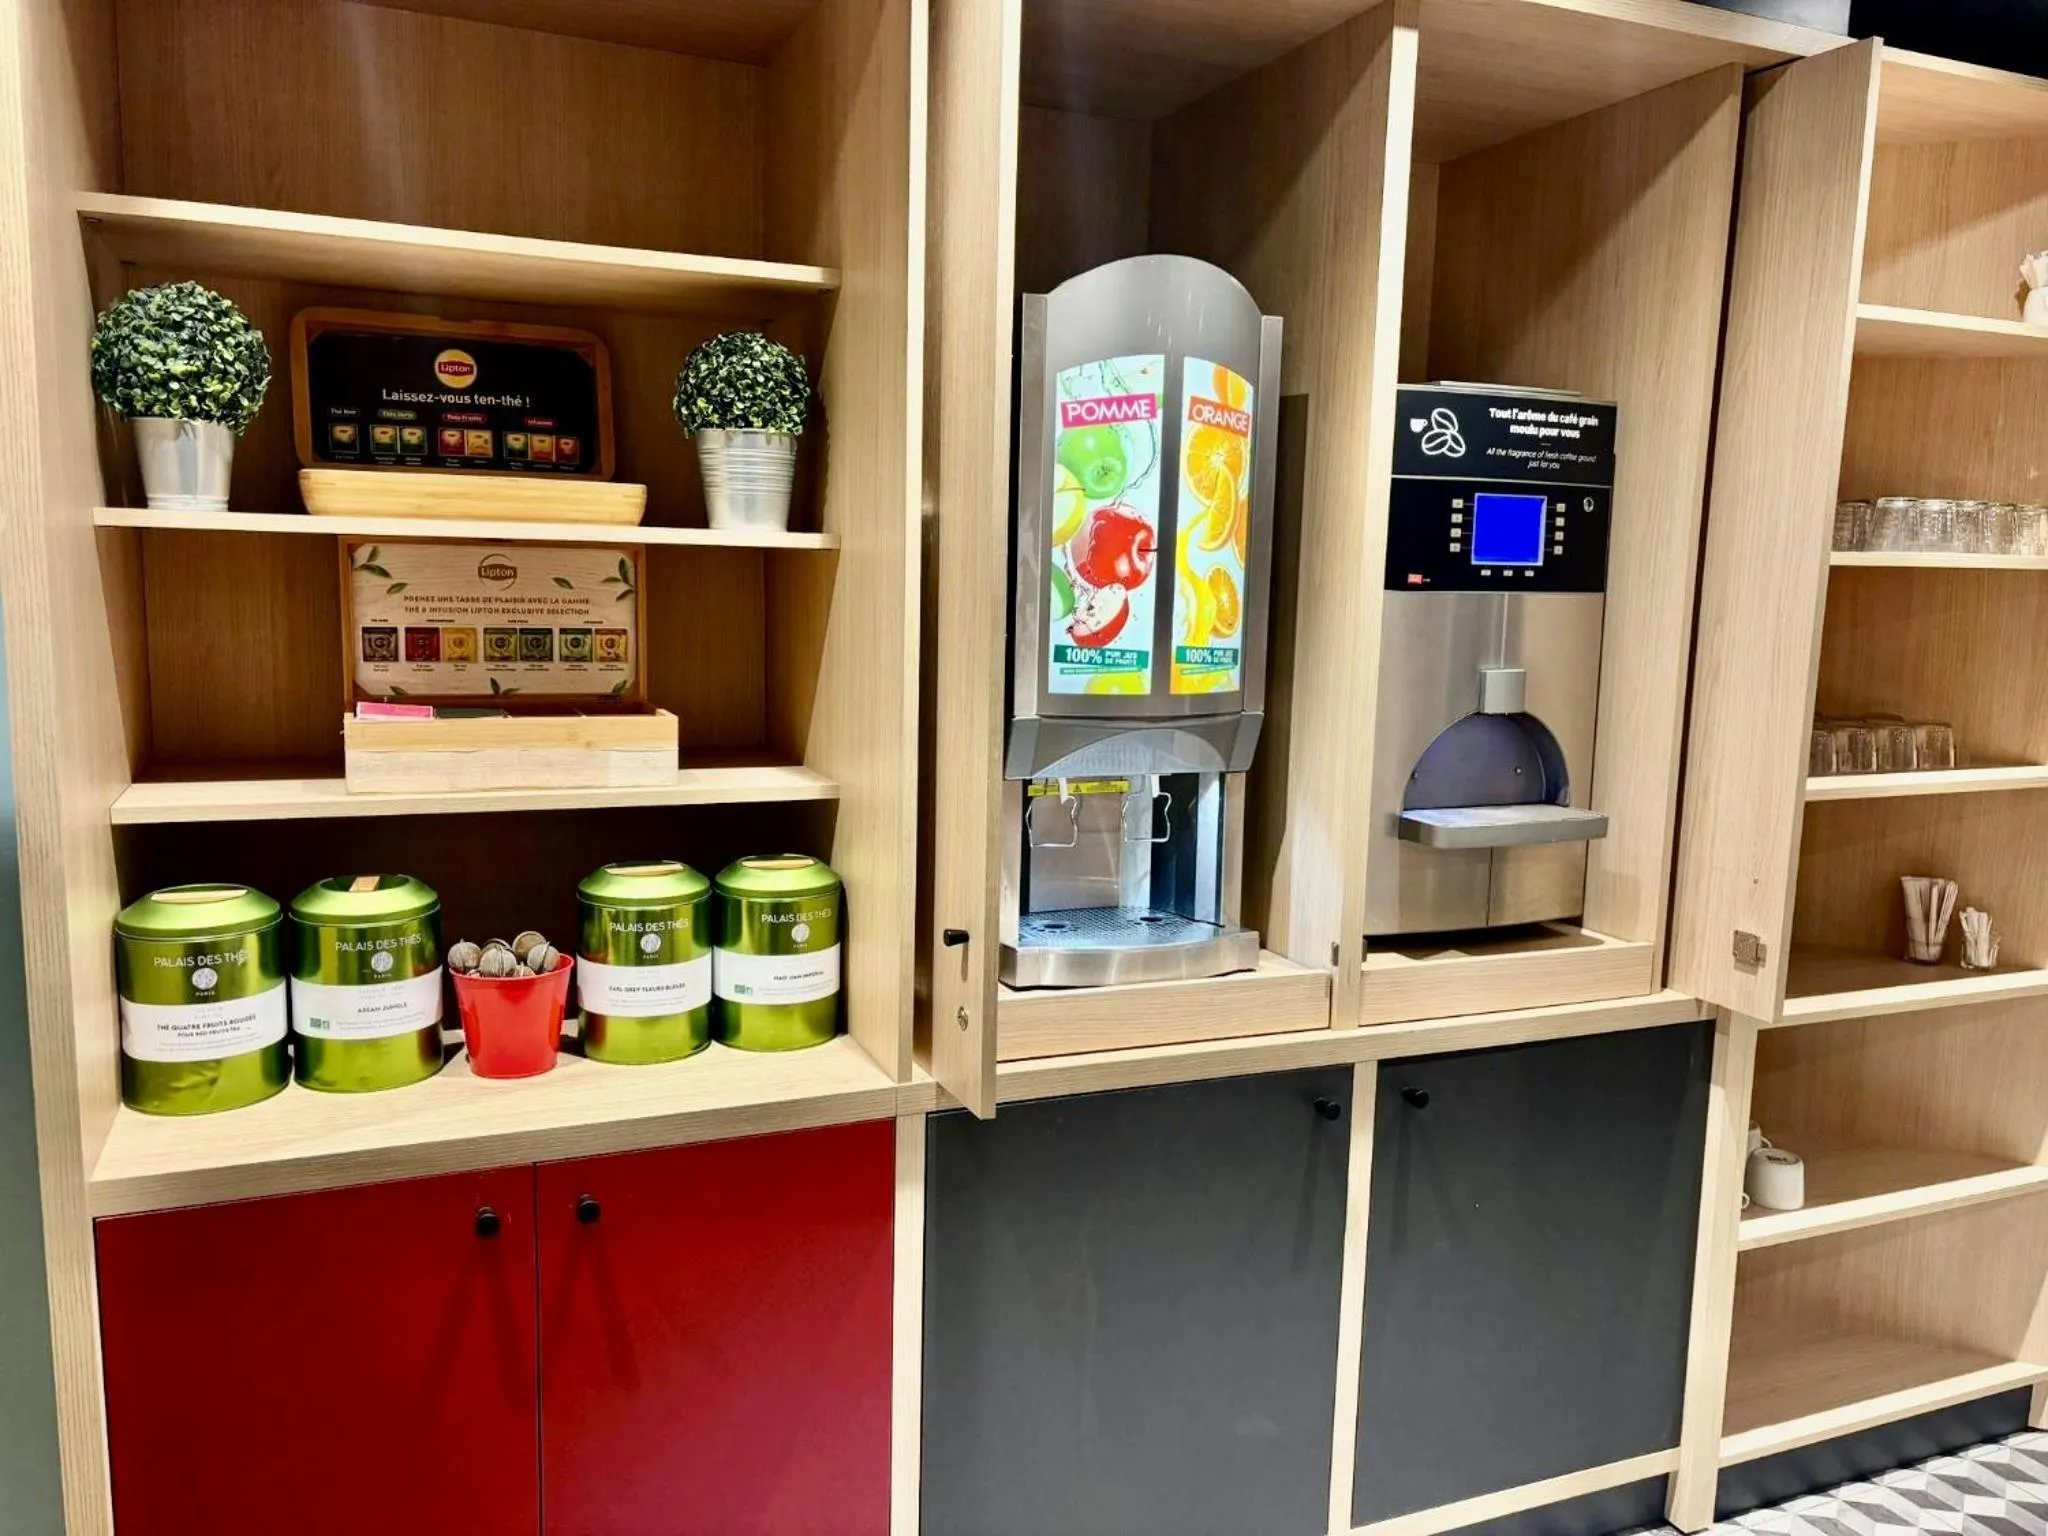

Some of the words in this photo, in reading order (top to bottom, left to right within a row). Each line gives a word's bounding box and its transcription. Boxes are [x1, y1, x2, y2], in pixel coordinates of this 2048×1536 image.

[441, 363, 471, 374] Lipton
[382, 388, 471, 404] Laissez-vous
[474, 393, 522, 407] ten-thé
[1066, 399, 1151, 422] POMME
[1192, 403, 1248, 431] ORANGE
[1489, 408, 1511, 418] Tout
[1548, 411, 1558, 422] du
[1560, 413, 1577, 424] café
[1579, 415, 1599, 428] grain
[1510, 423, 1538, 435] moulu
[1539, 427, 1559, 438] pour
[1560, 429, 1580, 438] vous
[1507, 449, 1536, 459] fragrance
[481, 565, 515, 578] Lipton
[1066, 647, 1103, 664] 100%
[1186, 649, 1212, 663] 100%
[761, 912, 796, 924] PALAIS
[609, 921, 644, 932] PALAIS
[645, 920, 666, 932] DES
[335, 941, 374, 952] PALAIS
[375, 938, 397, 950] DES
[153, 956, 195, 968] PALAIS
[197, 954, 222, 967] DES
[171, 1023, 201, 1031] QUATRE
[202, 1019, 228, 1029] FRUITS
